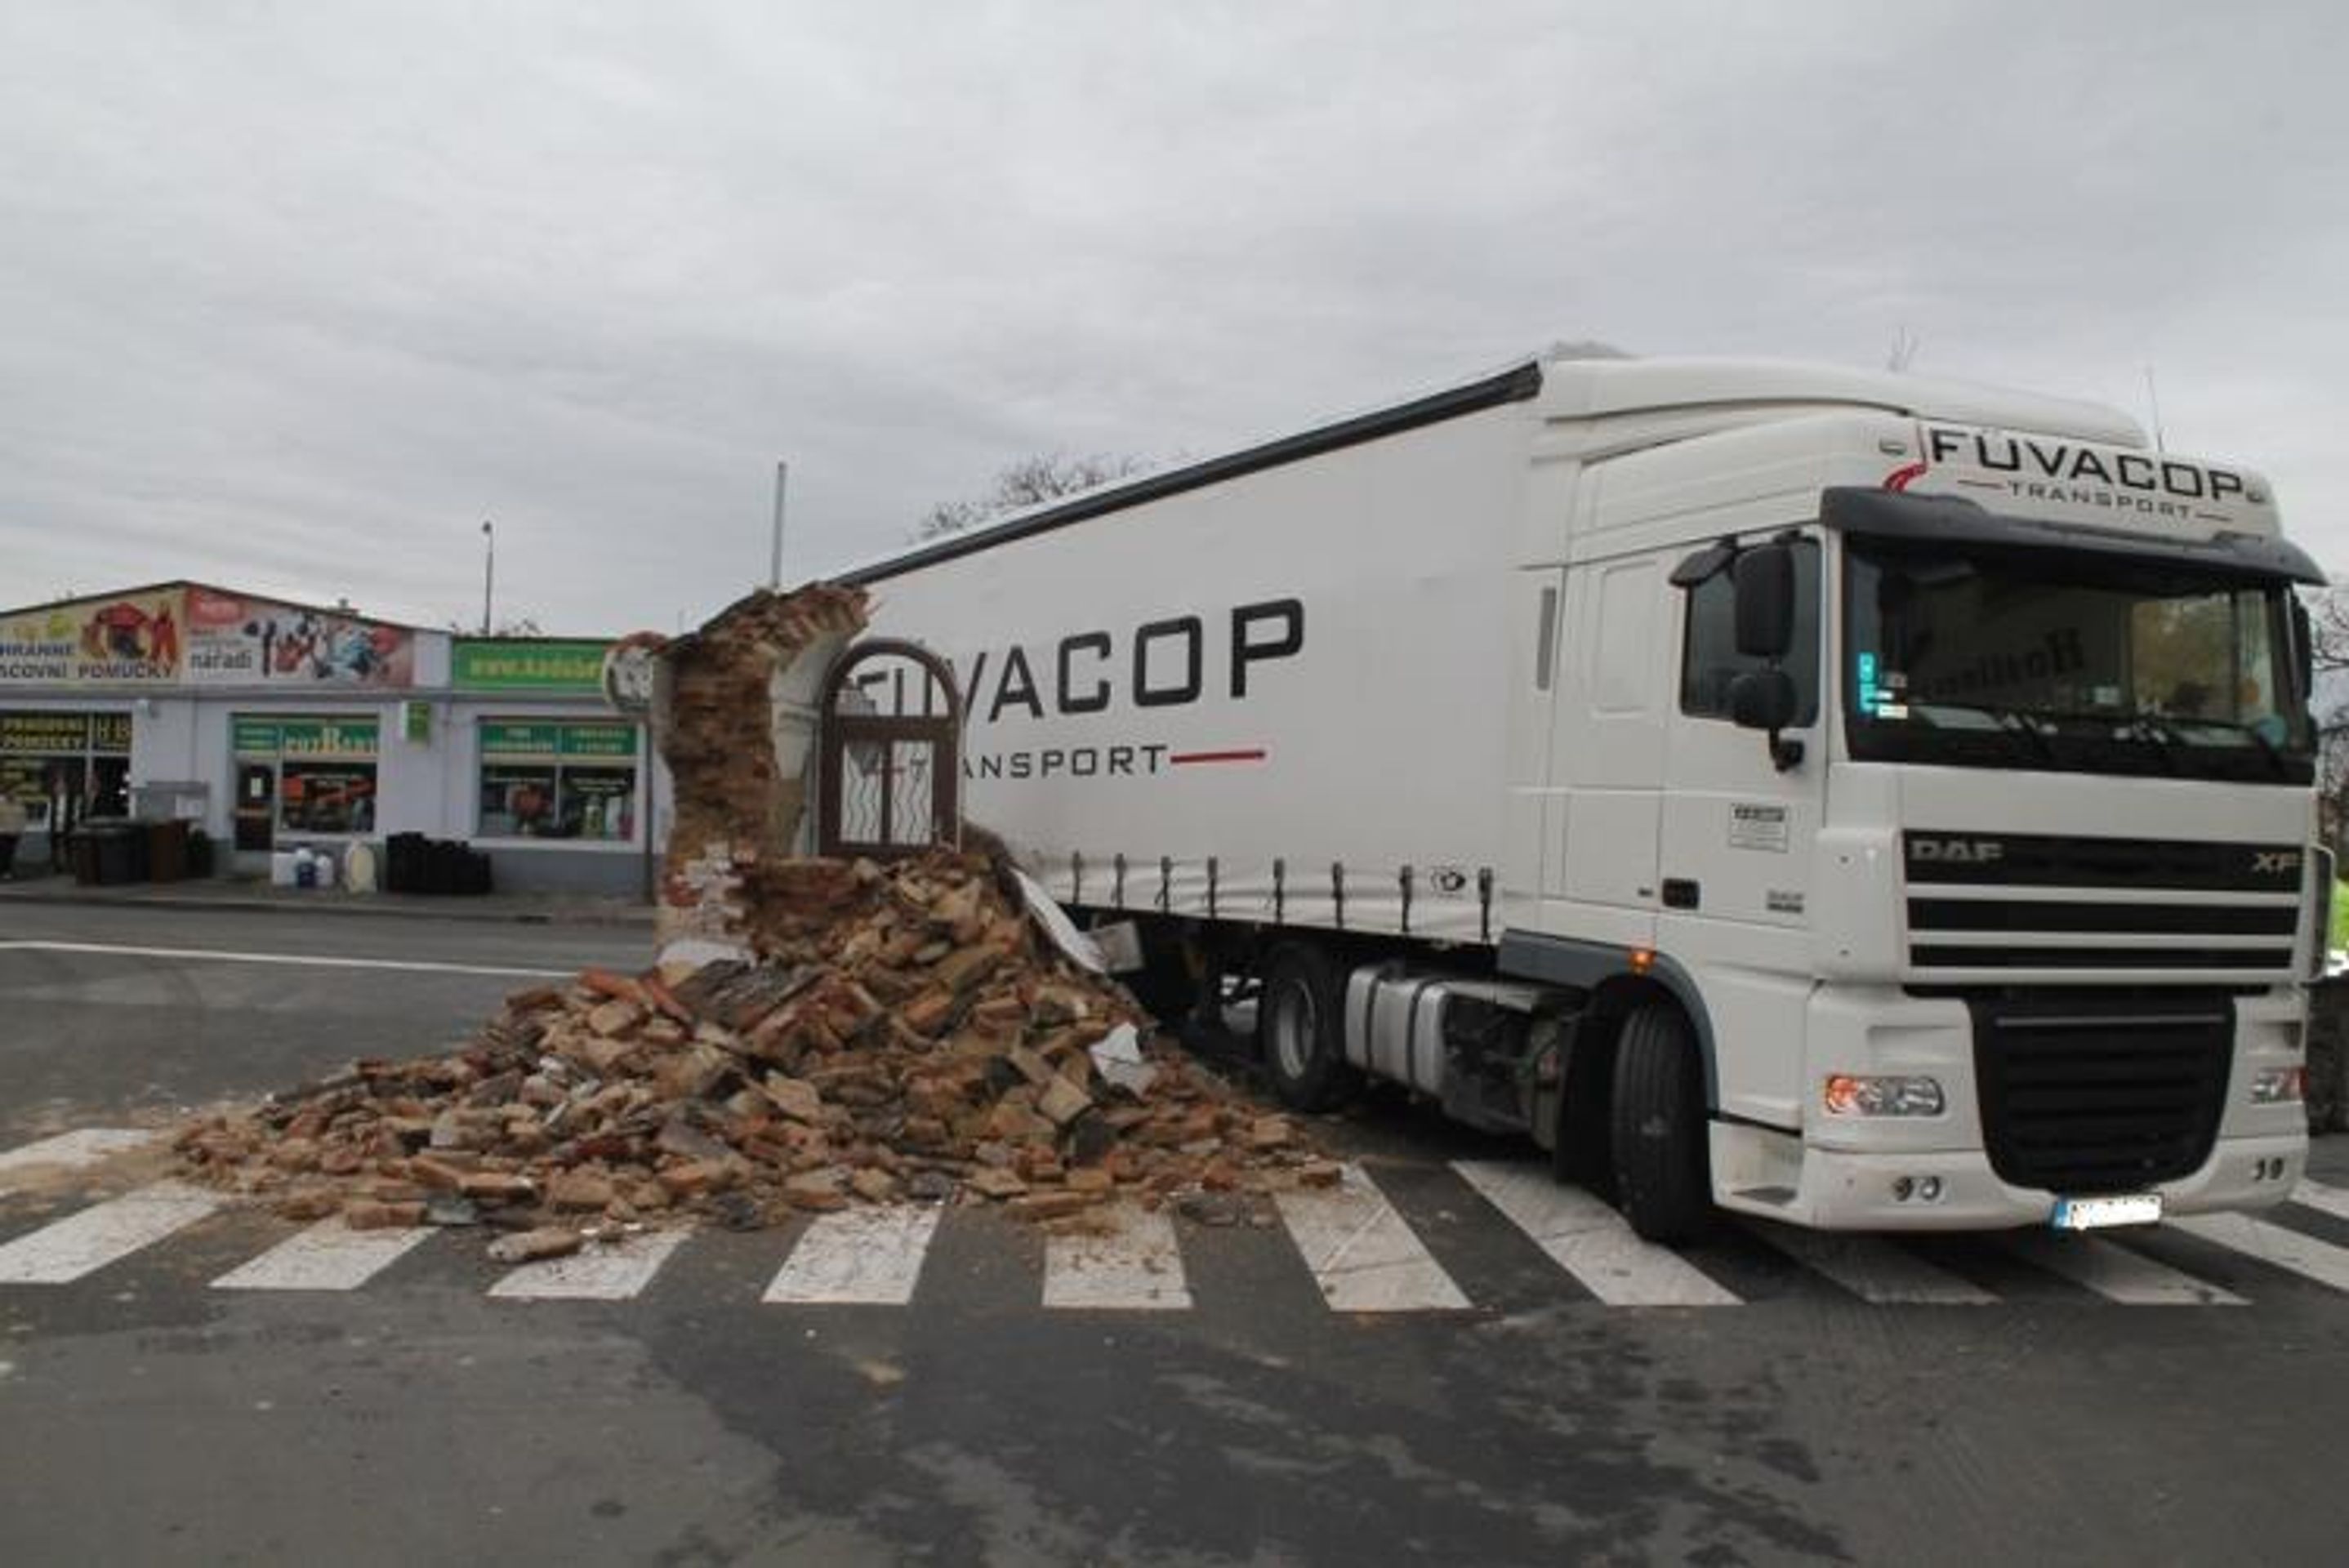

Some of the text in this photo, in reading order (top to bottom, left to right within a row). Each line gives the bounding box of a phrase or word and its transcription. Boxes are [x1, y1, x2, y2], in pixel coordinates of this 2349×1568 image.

[1928, 427, 2243, 501] FUVACOP
[2007, 479, 2191, 518] TRANSPORT
[908, 745, 1168, 782] TNSPORT
[1911, 840, 2004, 864] DAF
[2252, 852, 2300, 875] XF
